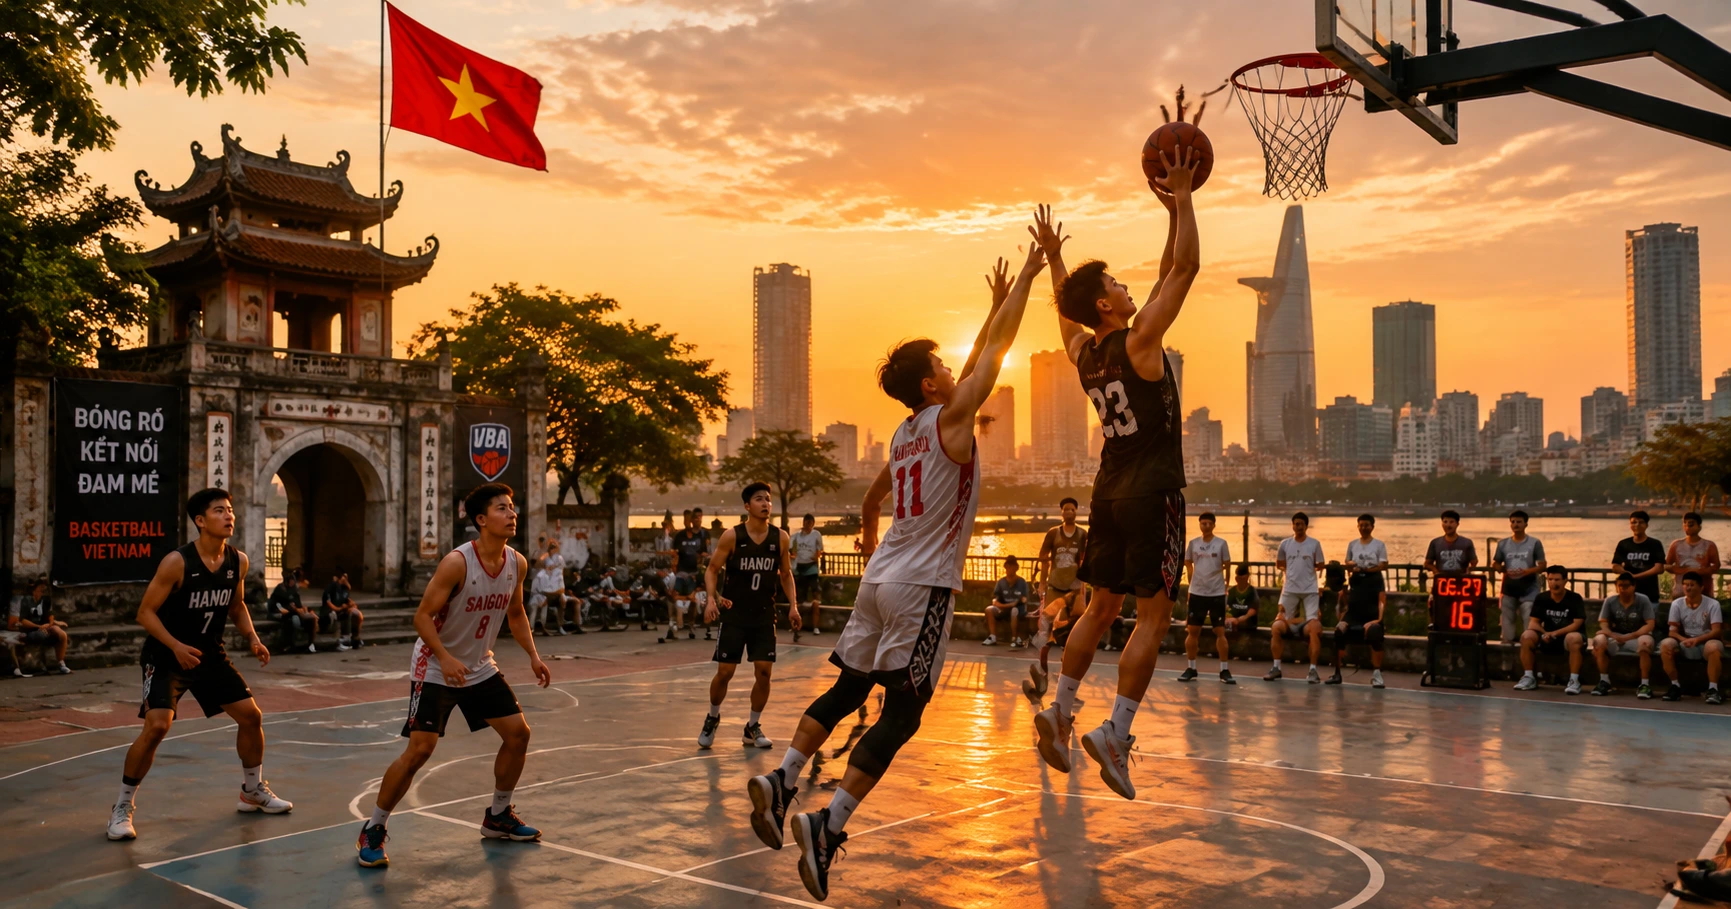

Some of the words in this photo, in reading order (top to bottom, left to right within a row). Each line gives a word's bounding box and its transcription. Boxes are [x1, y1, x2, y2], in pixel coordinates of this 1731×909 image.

[1088, 380, 1138, 438] 23
[473, 427, 508, 449] VBA
[77, 473, 125, 494] ĐAM
[896, 460, 924, 519] 11
[69, 521, 166, 538] BASKETBALL
[82, 543, 152, 560] VIETNAM
[740, 557, 775, 571] HANOI
[751, 573, 761, 591] 0
[188, 588, 233, 609] HANOI
[465, 593, 511, 612] SAIGON
[201, 611, 214, 634] 7
[1450, 600, 1473, 629] 16
[474, 614, 491, 639] 8
